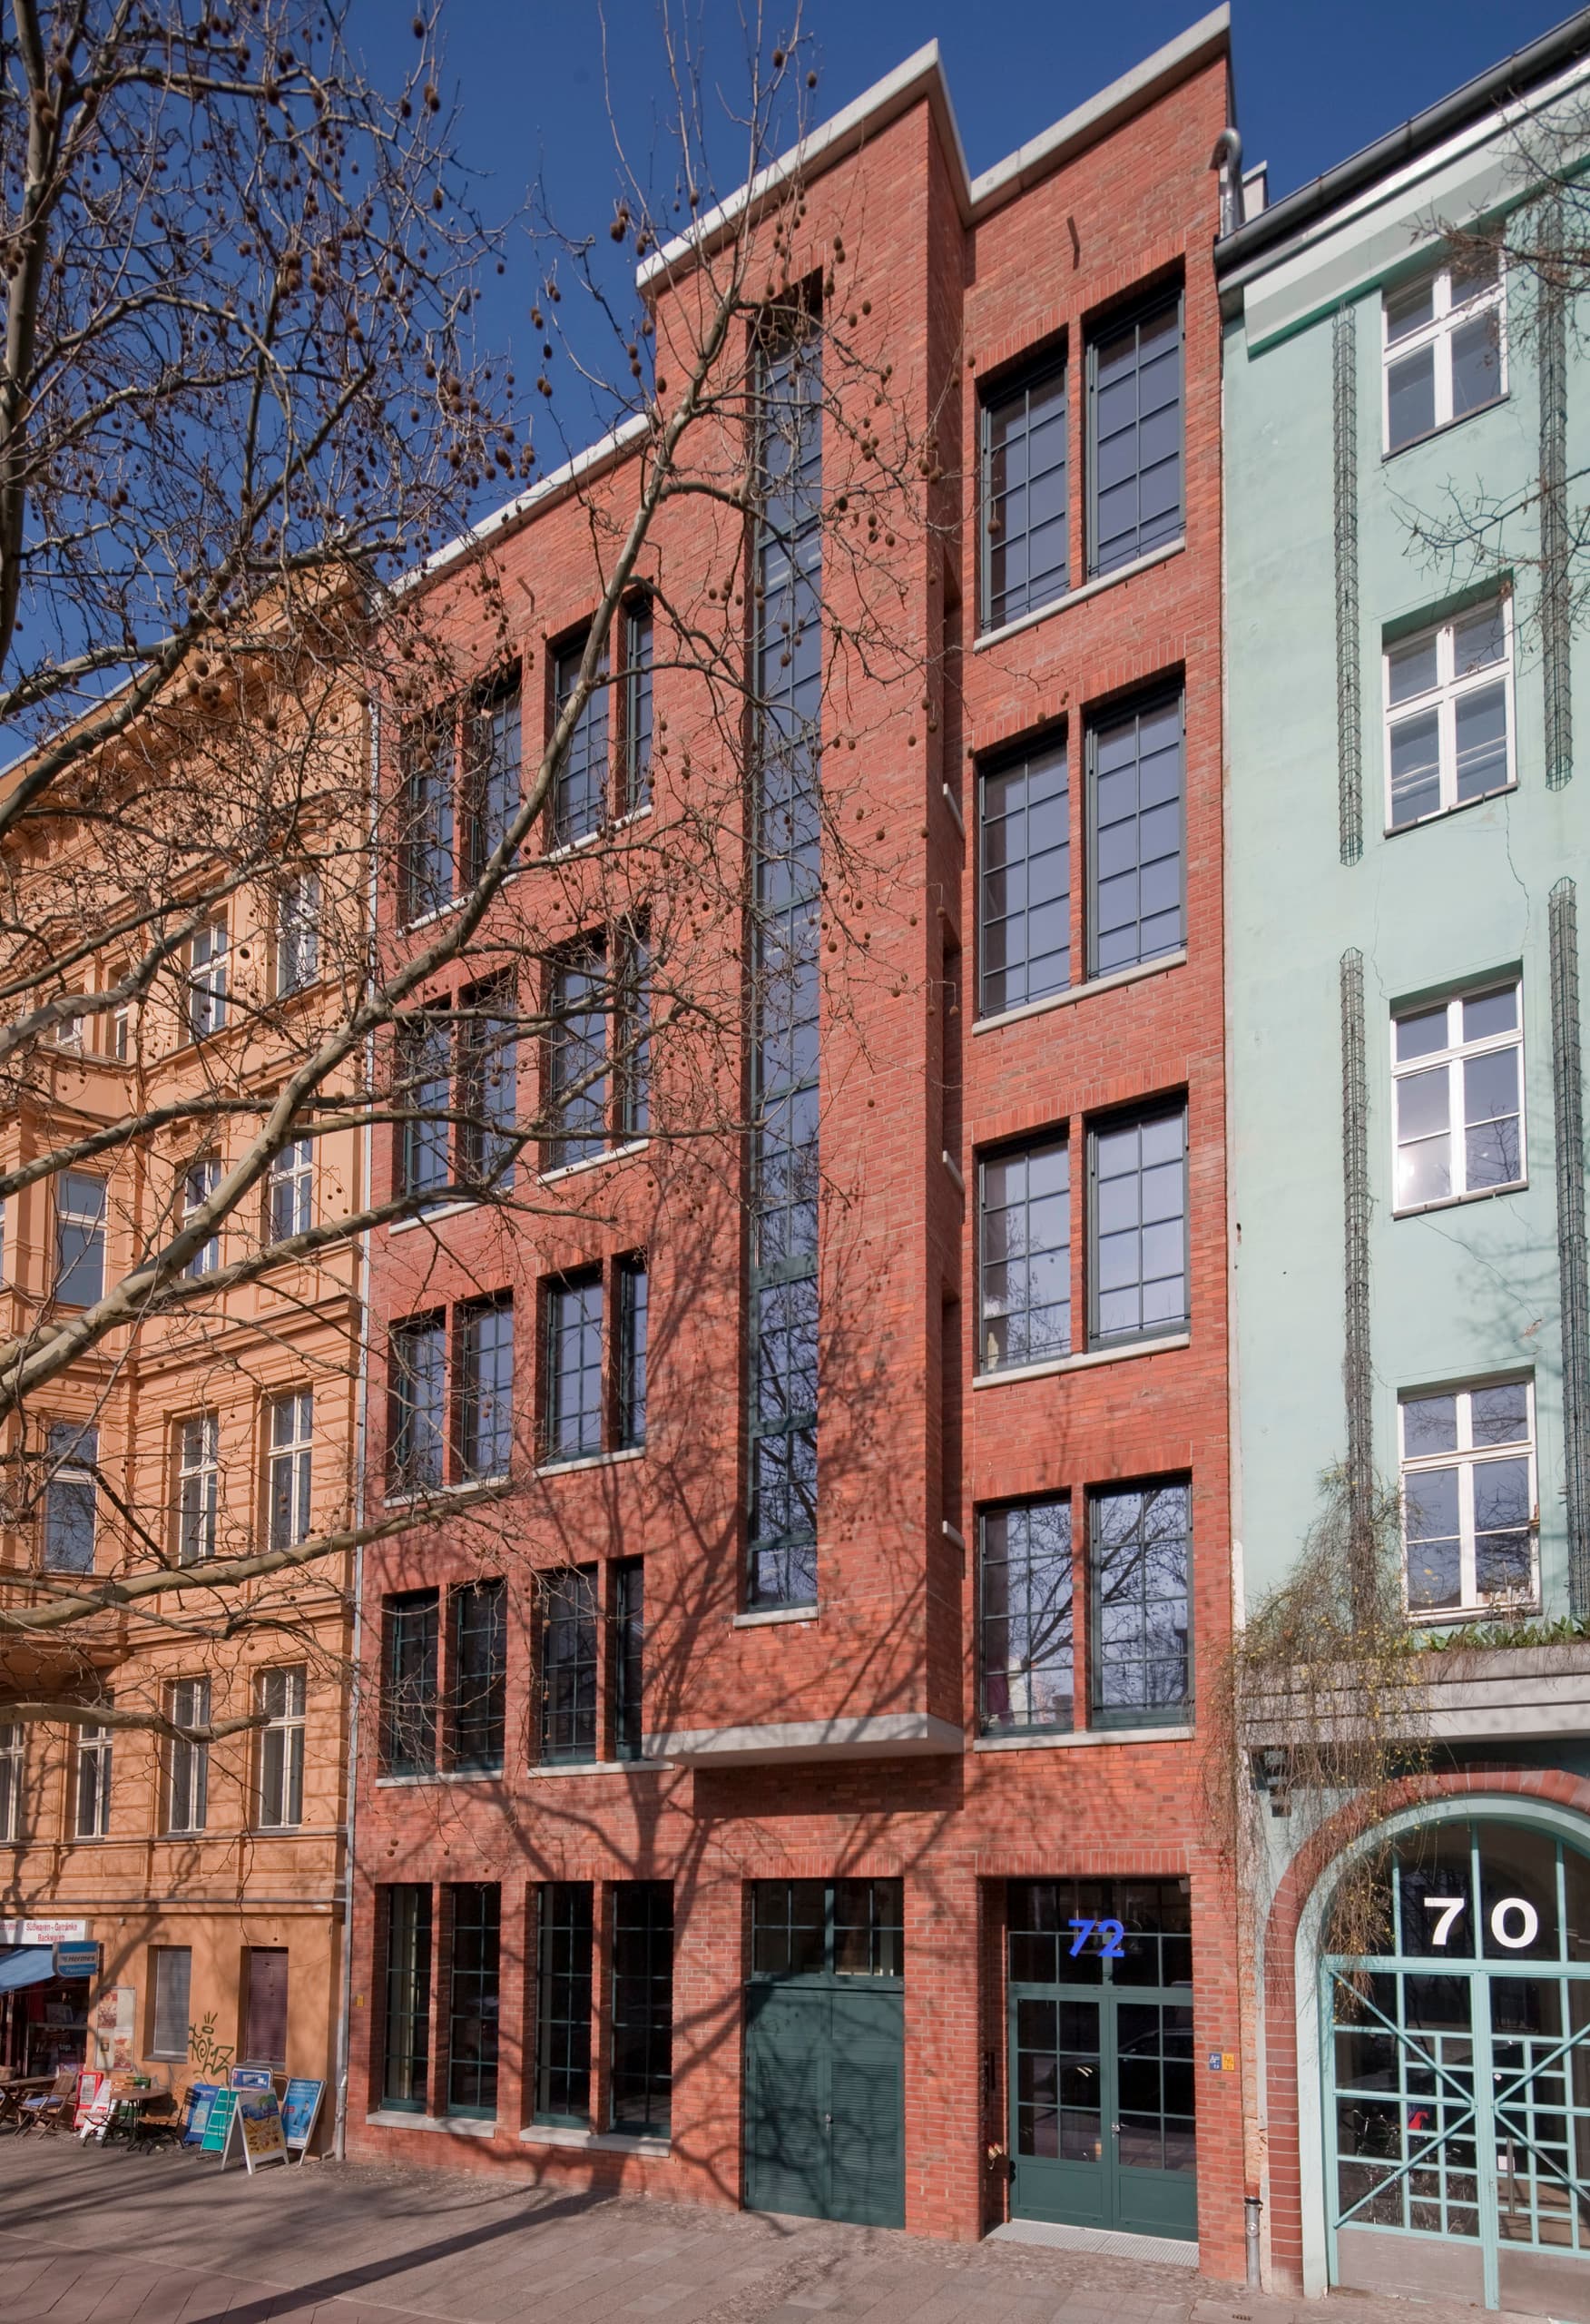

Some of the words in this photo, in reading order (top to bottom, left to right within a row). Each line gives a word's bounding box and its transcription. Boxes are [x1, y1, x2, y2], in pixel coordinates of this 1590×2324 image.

[26, 1923, 51, 1931] Süßwaren
[54, 1923, 77, 1931] Getränke
[1423, 1897, 1538, 1949] 70
[37, 1933, 65, 1942] Backwaren
[1068, 1919, 1125, 1957] 72
